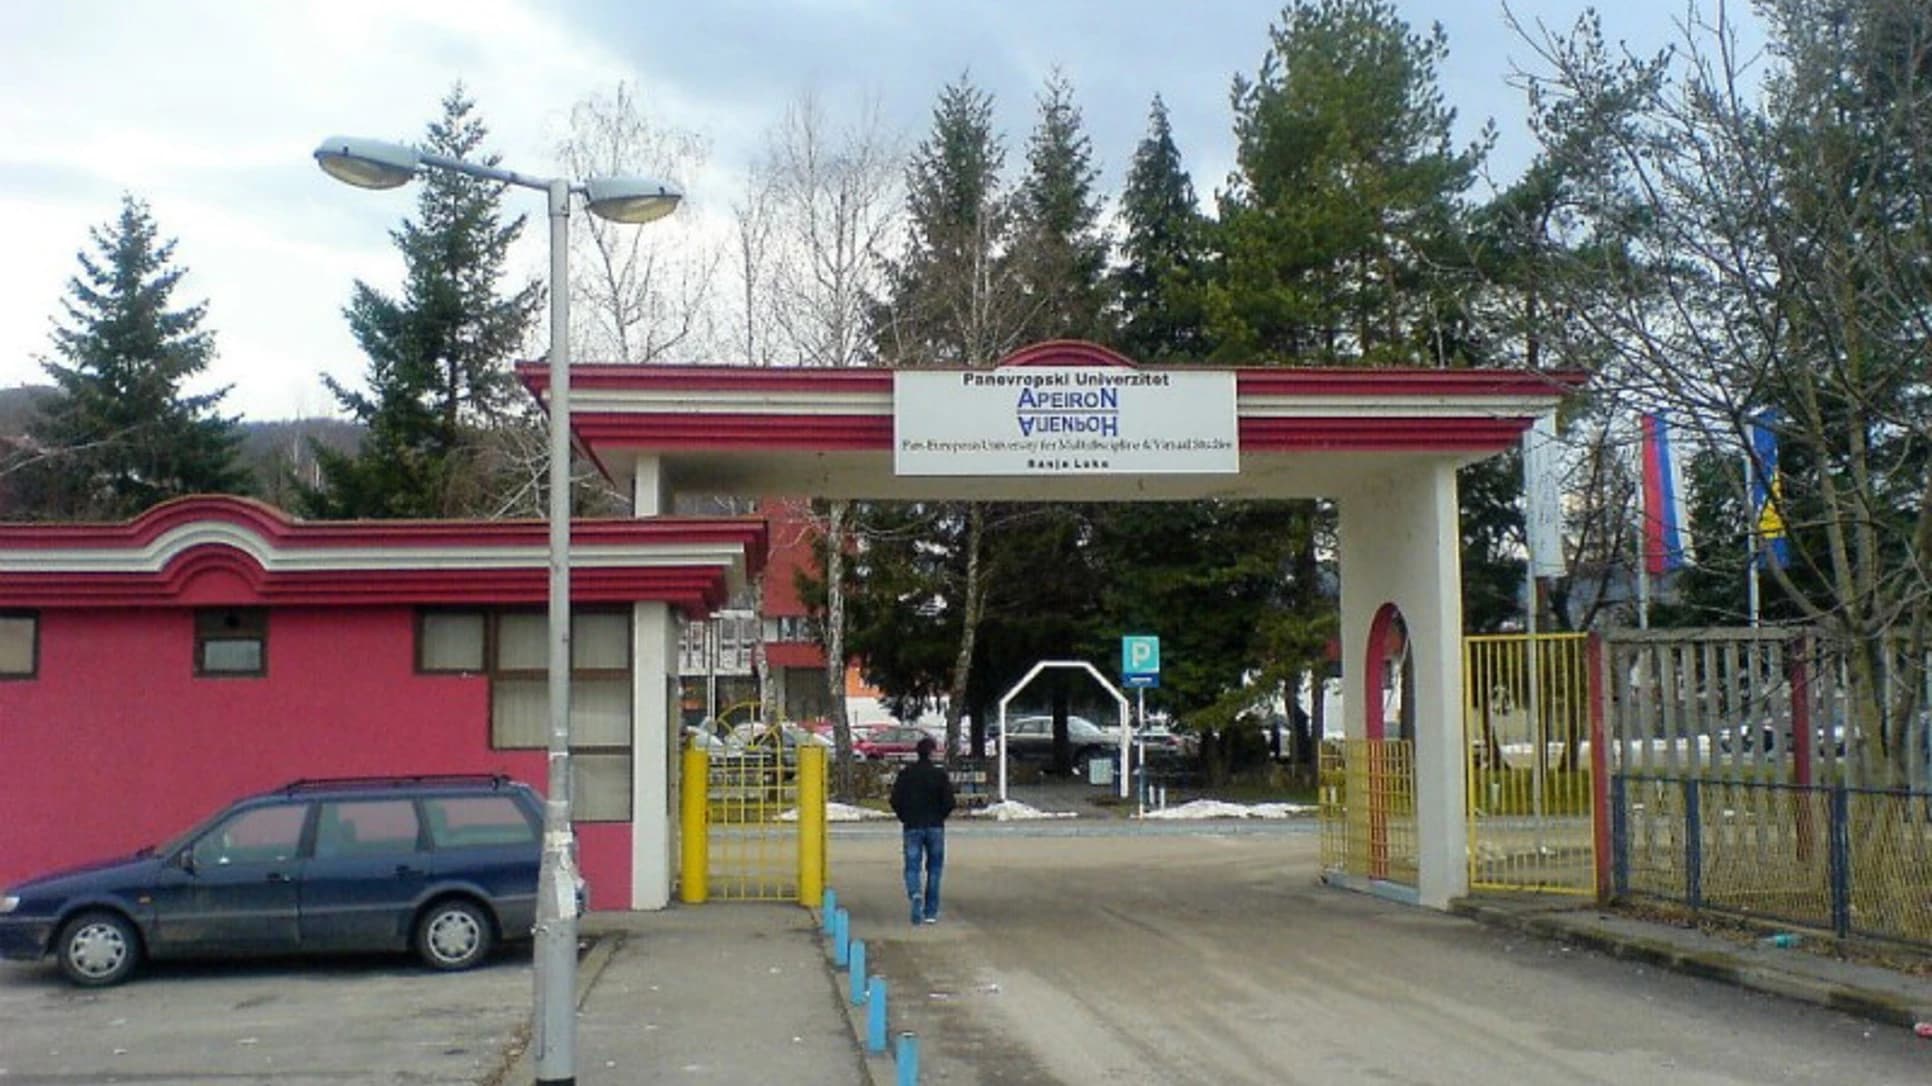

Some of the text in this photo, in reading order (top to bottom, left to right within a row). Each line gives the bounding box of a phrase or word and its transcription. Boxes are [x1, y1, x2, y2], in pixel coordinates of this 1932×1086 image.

[963, 372, 1169, 388] Panevropski Univerzitet
[1017, 387, 1118, 408] APEIRON
[1132, 642, 1151, 668] P
